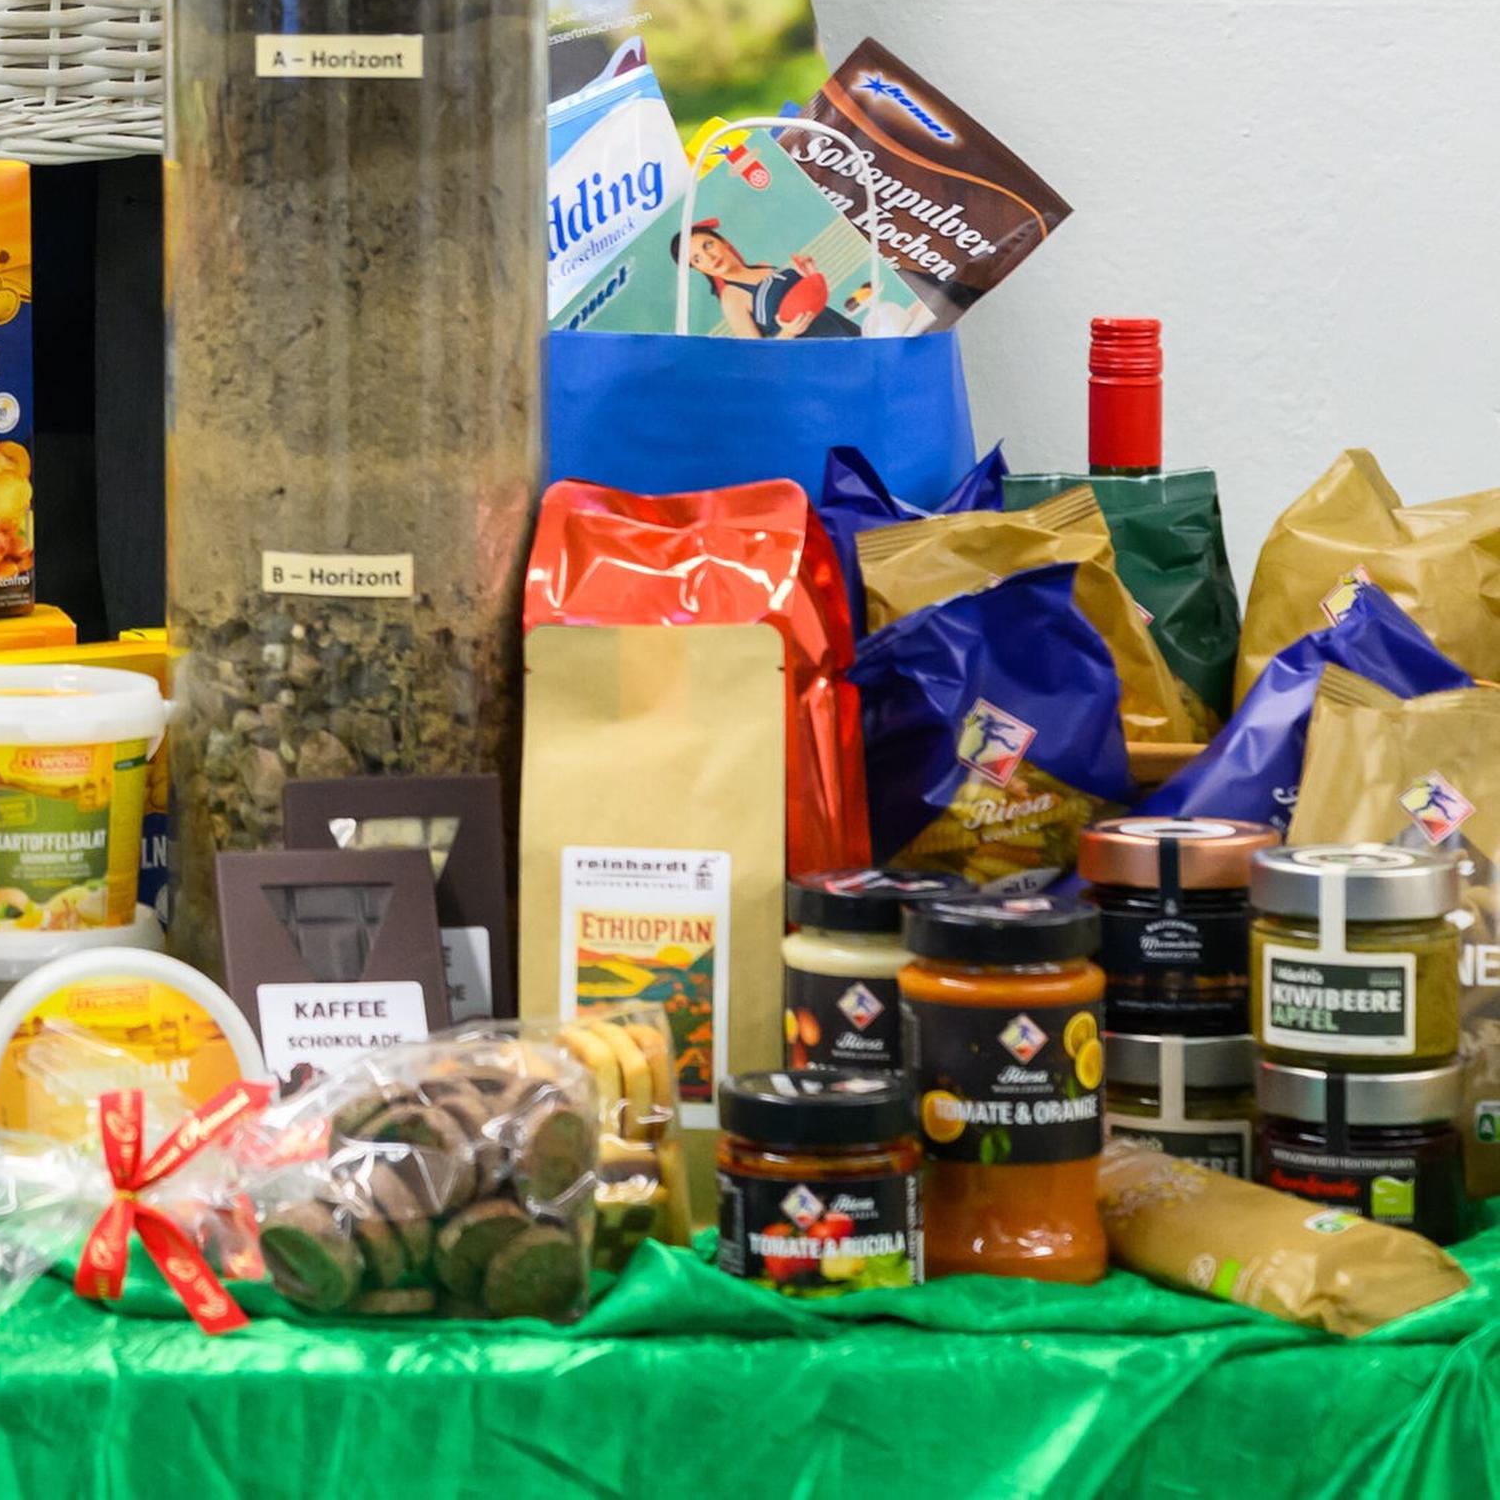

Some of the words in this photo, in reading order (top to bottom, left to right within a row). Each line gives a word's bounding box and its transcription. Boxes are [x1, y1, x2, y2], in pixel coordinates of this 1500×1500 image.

[273, 51, 286, 67] A
[311, 51, 404, 69] Horizont
[273, 567, 284, 583] B
[310, 567, 402, 586] Horizont
[577, 857, 688, 872] reinhardt
[581, 913, 713, 943] ETHIOPIAN
[295, 1000, 387, 1019] KAFFEE
[1273, 983, 1403, 1013] KIWIBEERE
[1273, 1004, 1340, 1032] APFEL
[288, 1033, 403, 1051] SCHOKOLADE
[934, 1096, 1014, 1125] TOMATE
[748, 1230, 822, 1260] TOMATE
